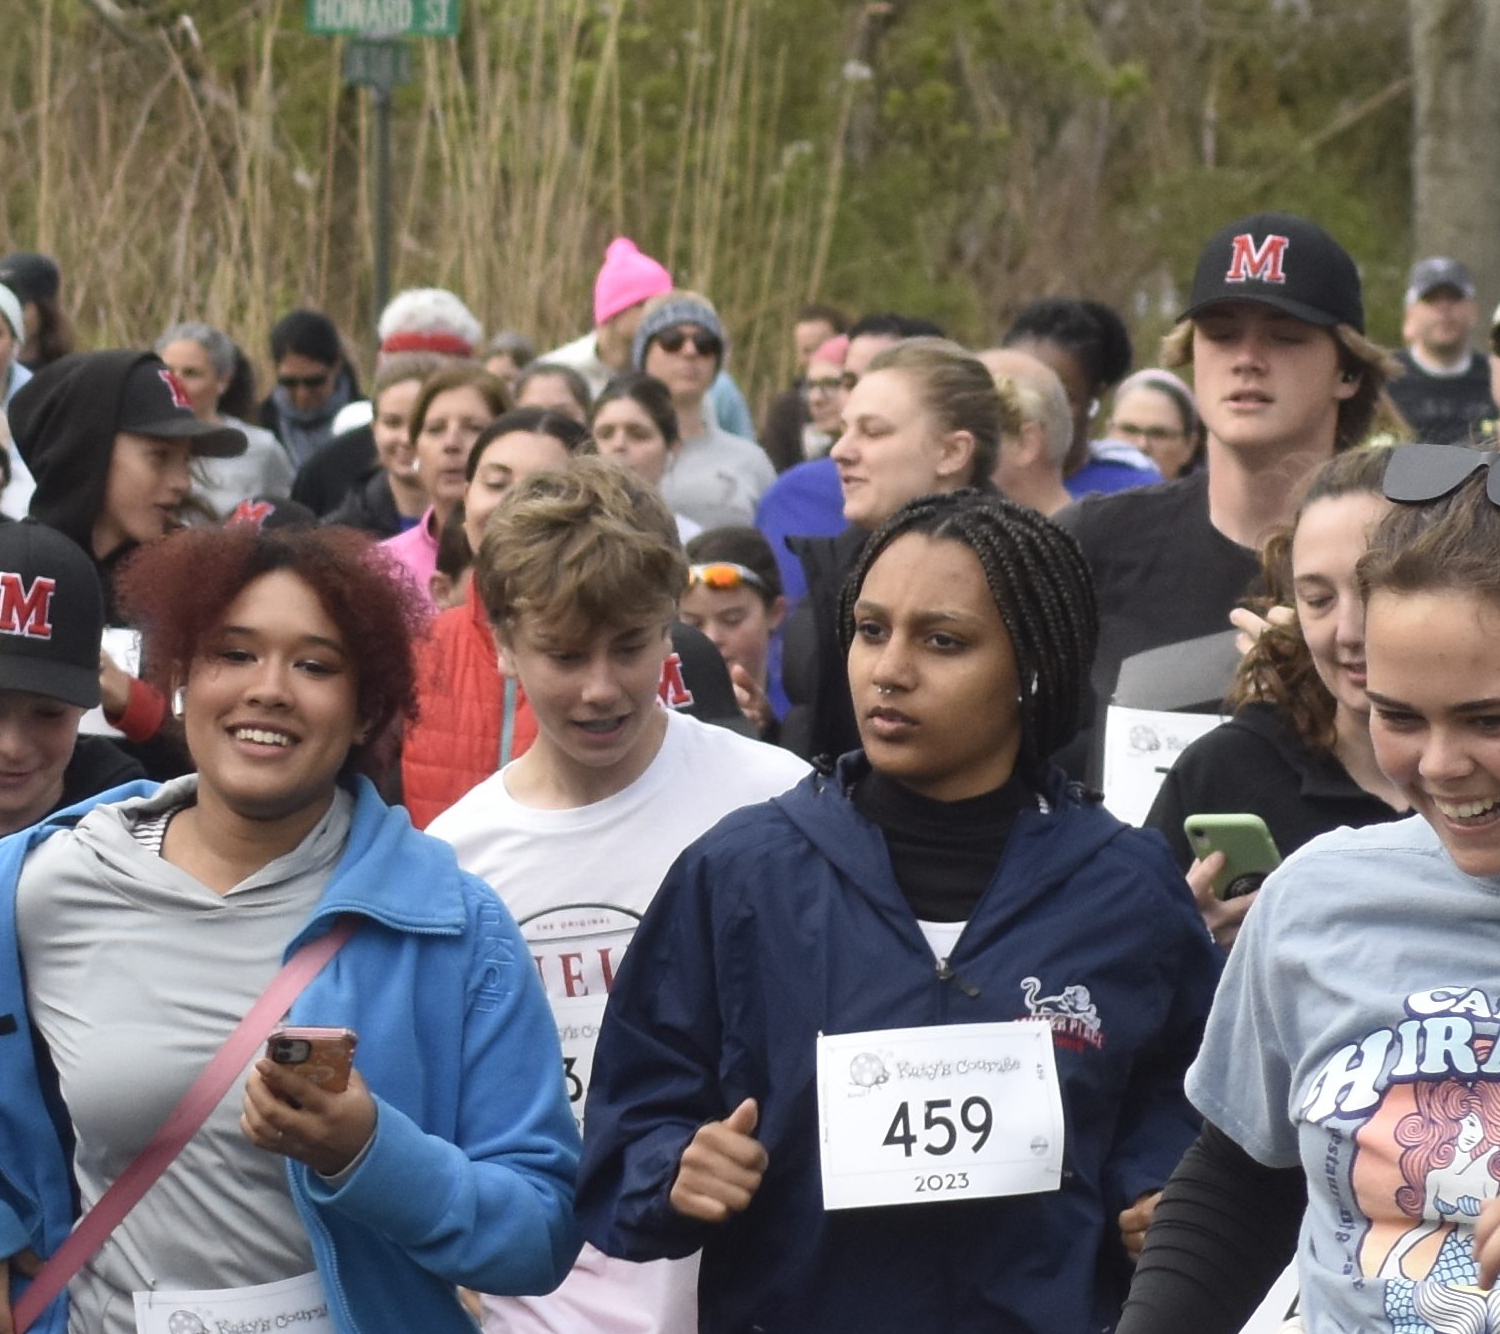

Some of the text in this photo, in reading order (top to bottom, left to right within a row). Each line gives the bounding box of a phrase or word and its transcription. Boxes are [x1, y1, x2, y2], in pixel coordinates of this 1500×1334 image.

[1225, 233, 1290, 284] M
[560, 916, 611, 930] ORIGINAL
[896, 1055, 1021, 1080] Katy's Courage
[882, 1095, 994, 1158] 459
[914, 1172, 970, 1193] 2023
[275, 1303, 328, 1329] Coura
